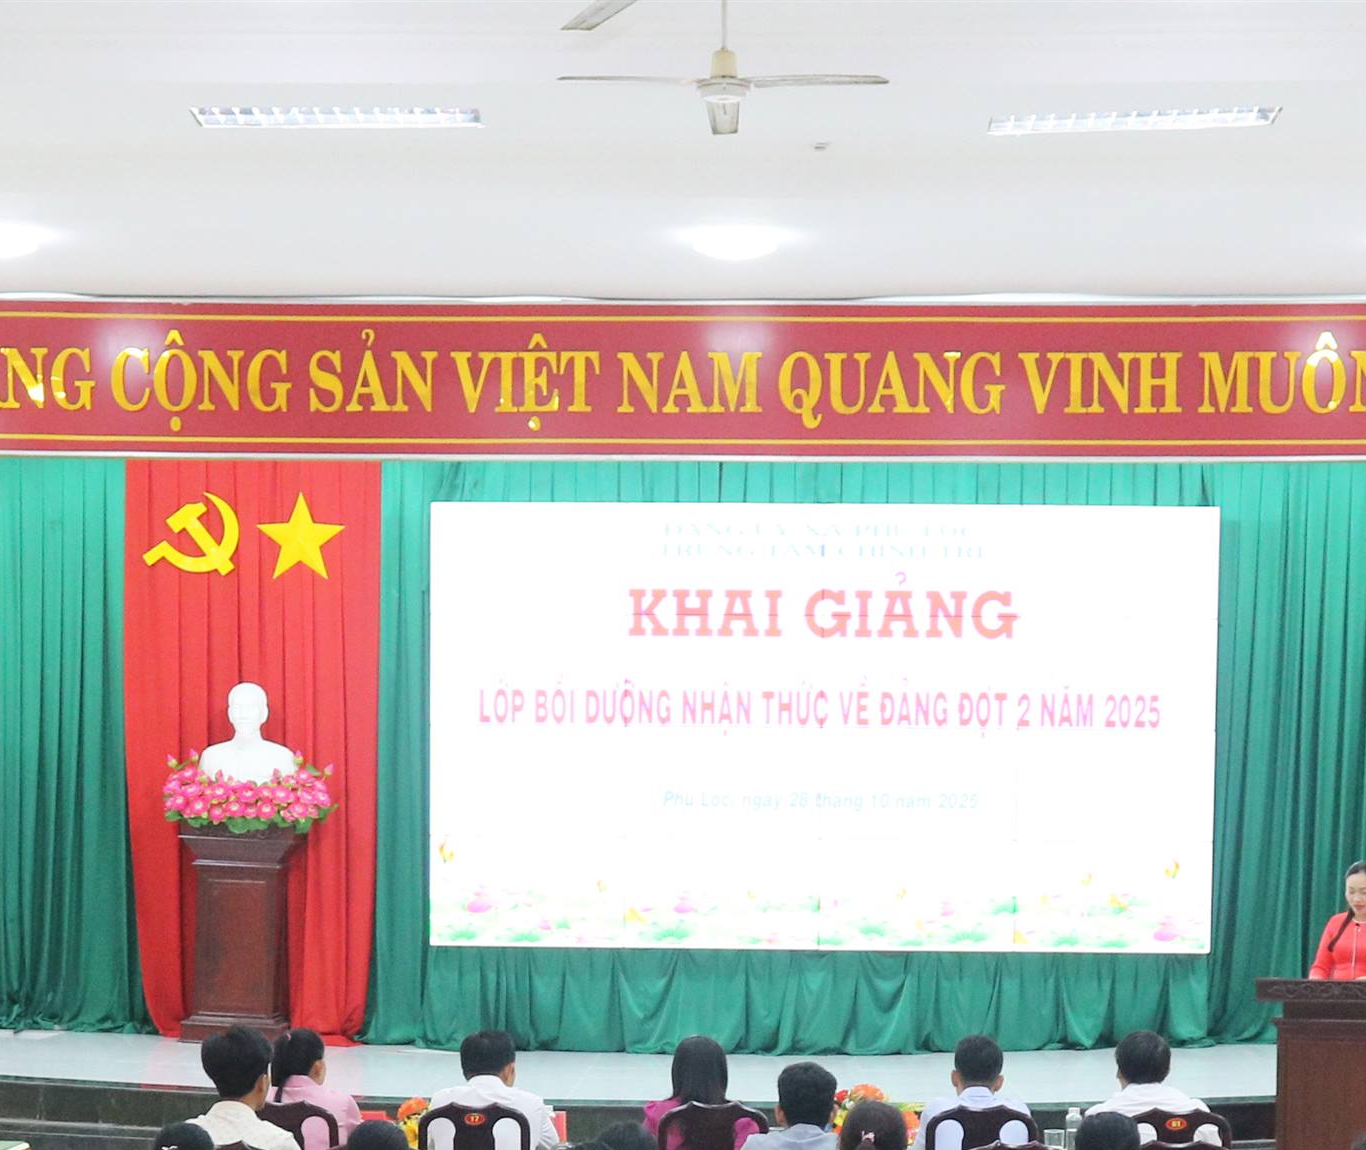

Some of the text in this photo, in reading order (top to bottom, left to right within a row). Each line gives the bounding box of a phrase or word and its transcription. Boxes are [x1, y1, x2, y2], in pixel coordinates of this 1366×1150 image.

[111, 330, 291, 431] CỘNG
[309, 328, 437, 413] SẢN
[451, 333, 600, 431] VIỆT
[618, 351, 763, 413] NAM
[778, 350, 1004, 428] QUANG
[1019, 351, 1183, 414] VINH
[628, 571, 1021, 640] KHAI GIẢNG
[682, 682, 751, 736] NHẬN
[880, 678, 948, 728] ĐẢNG
[1016, 691, 1031, 730] 2
[1040, 686, 1094, 728] NĂM
[1104, 694, 1161, 730] 2025
